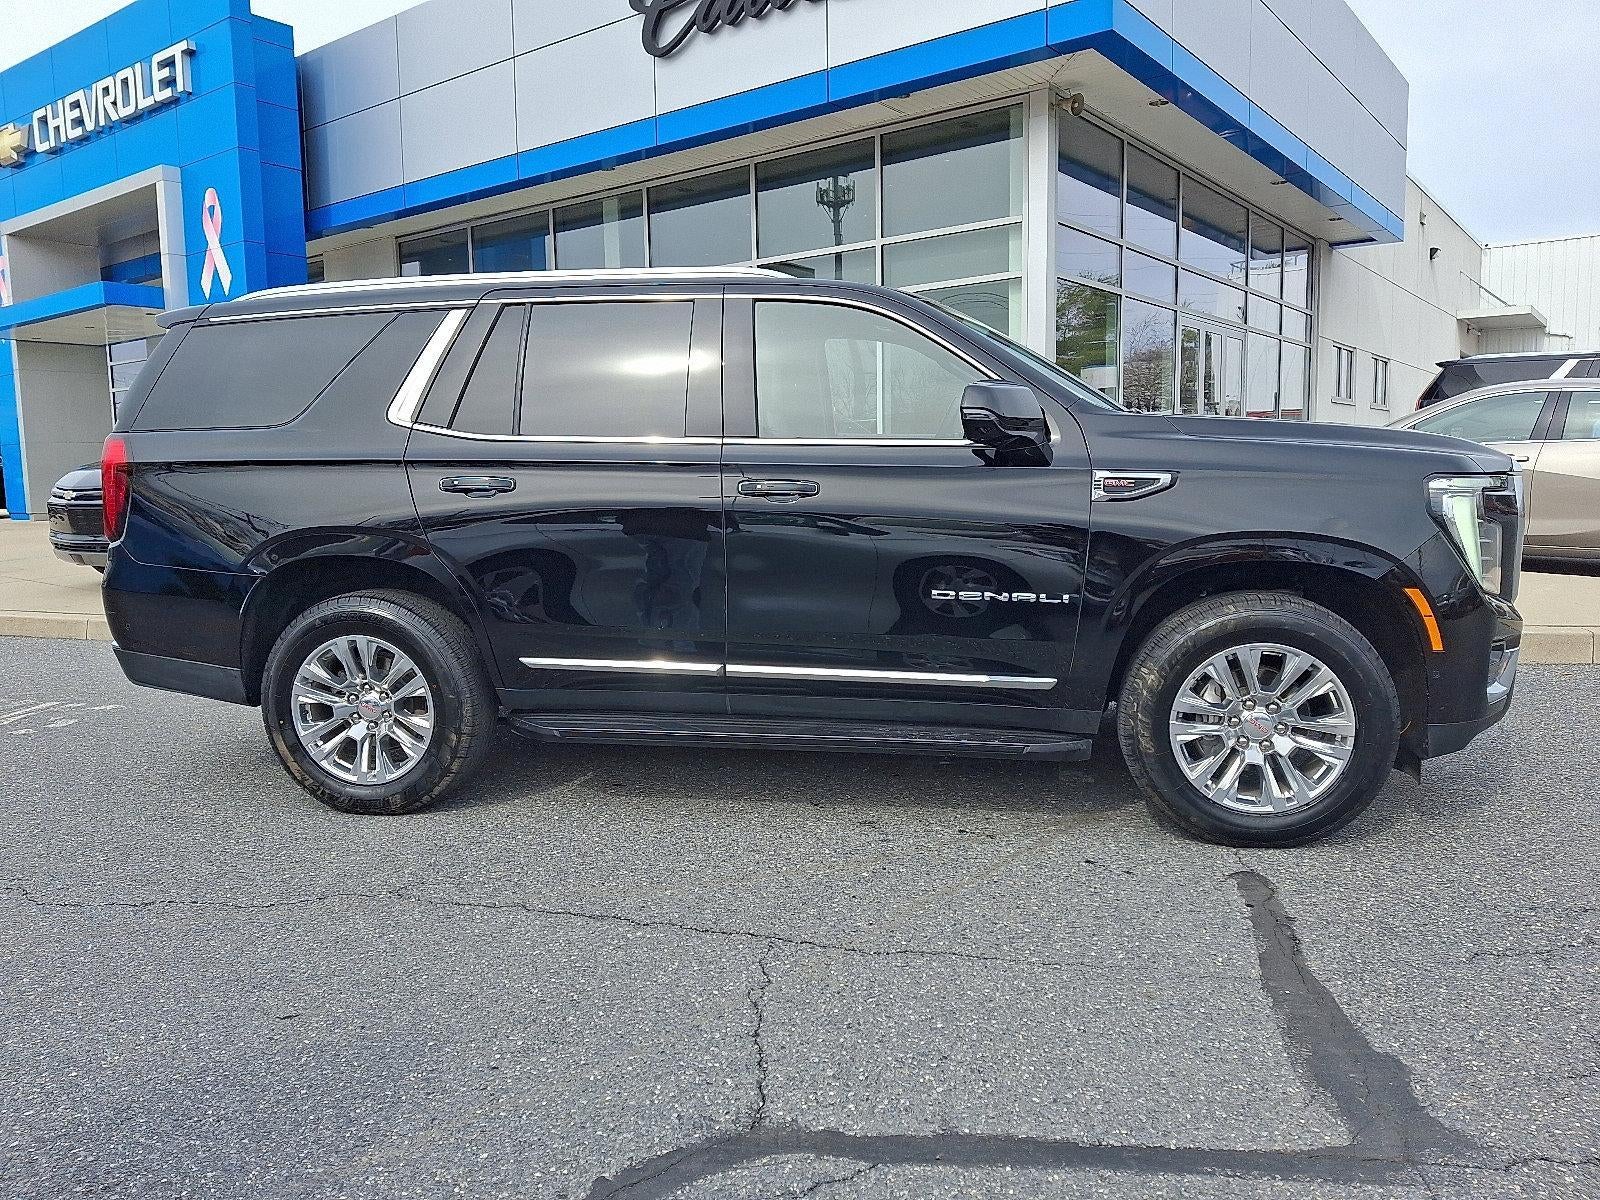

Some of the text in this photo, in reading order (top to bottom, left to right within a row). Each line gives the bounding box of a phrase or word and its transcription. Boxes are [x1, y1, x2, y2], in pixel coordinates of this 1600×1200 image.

[32, 39, 196, 153] CHEVROLET
[1104, 479, 1136, 487] GMC
[931, 589, 1070, 604] DENALI
